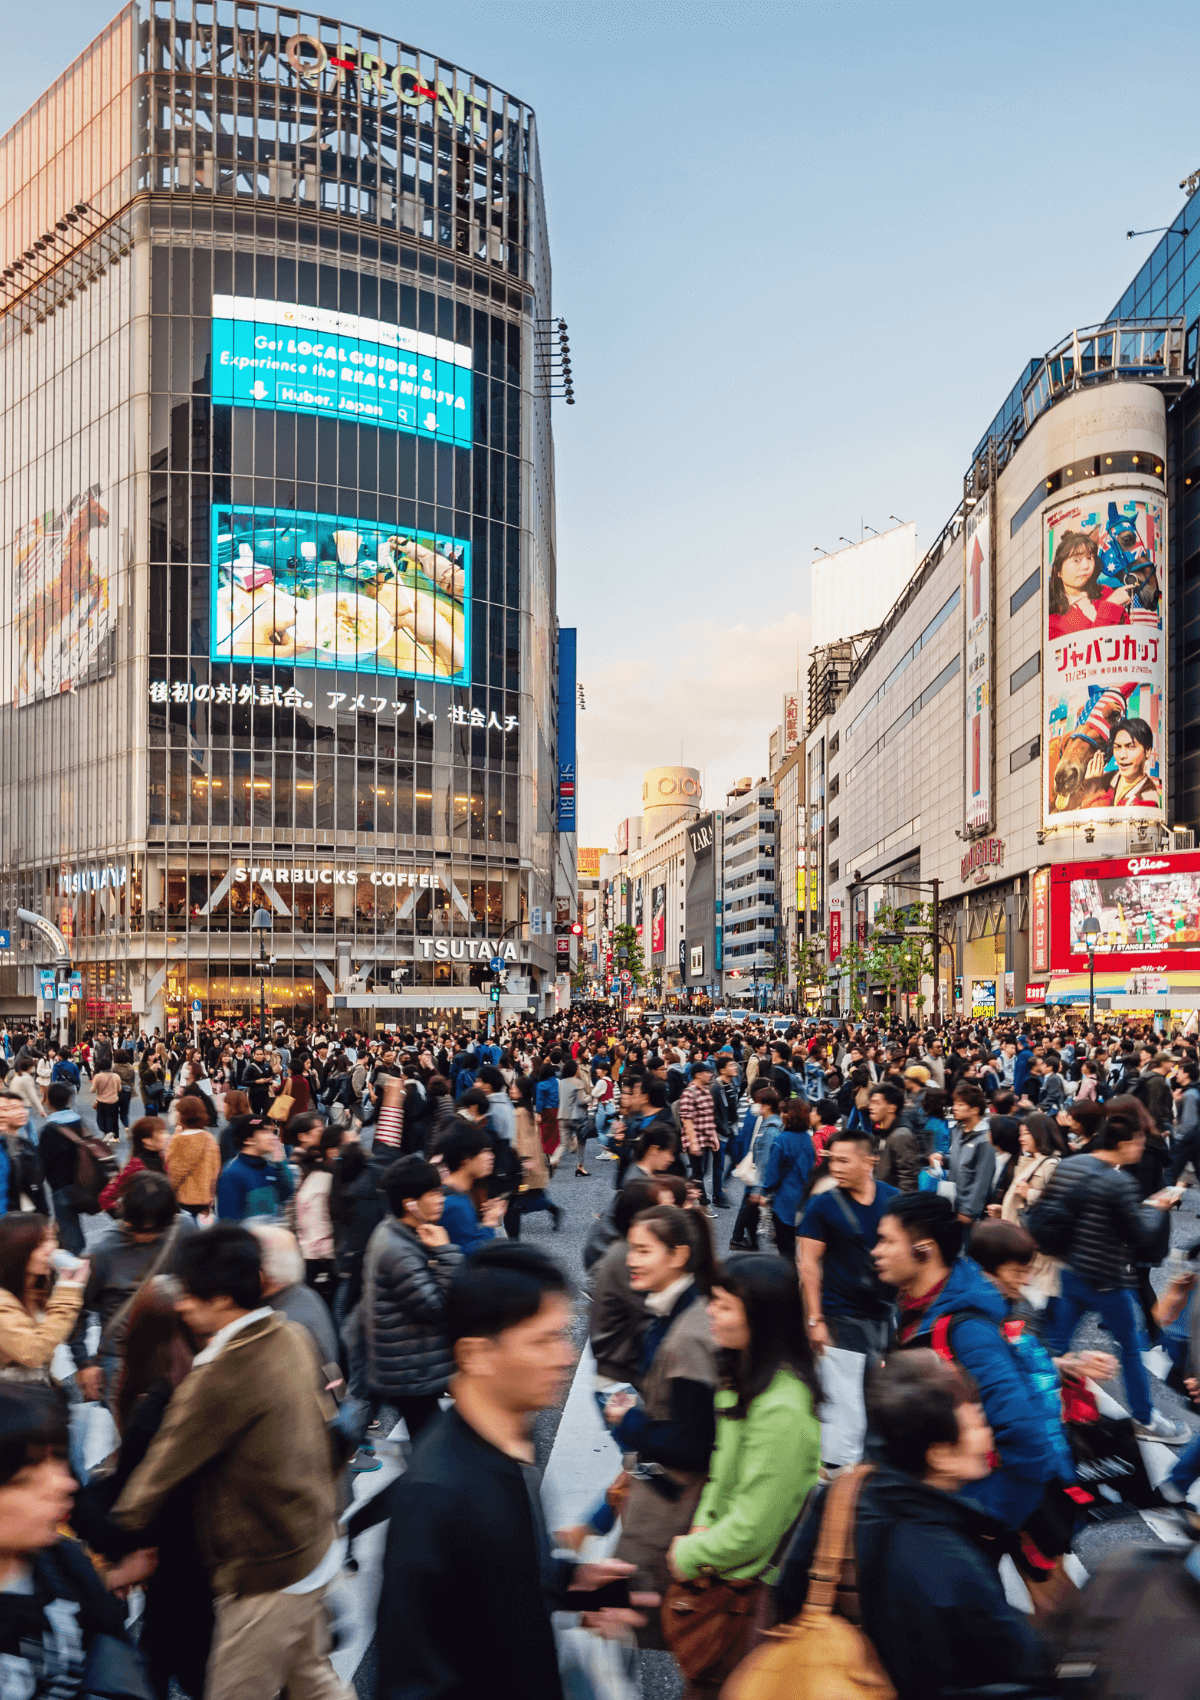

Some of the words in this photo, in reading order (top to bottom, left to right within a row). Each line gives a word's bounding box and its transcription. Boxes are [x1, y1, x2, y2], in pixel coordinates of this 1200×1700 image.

[255, 336, 282, 351] Get
[288, 340, 347, 362] LOCAL
[350, 350, 417, 377] GUIDES
[422, 369, 432, 382] &
[220, 351, 307, 374] Experience
[312, 363, 336, 378] the
[341, 367, 386, 389] REAL
[389, 379, 466, 410] SHIBUYA
[338, 397, 383, 416] Japan
[1055, 634, 1160, 672] ジャパンカップ
[1065, 669, 1087, 682] 11/25
[786, 696, 798, 742] 大和証券
[560, 763, 575, 818] SEIBU
[60, 866, 127, 893] TSUTAYA
[234, 867, 358, 885] STARBUCKS
[370, 871, 440, 888] COFFEE
[420, 939, 517, 960] TSUTAYA
[1117, 943, 1143, 951] STANCE
[1145, 942, 1169, 950] PUNKS
